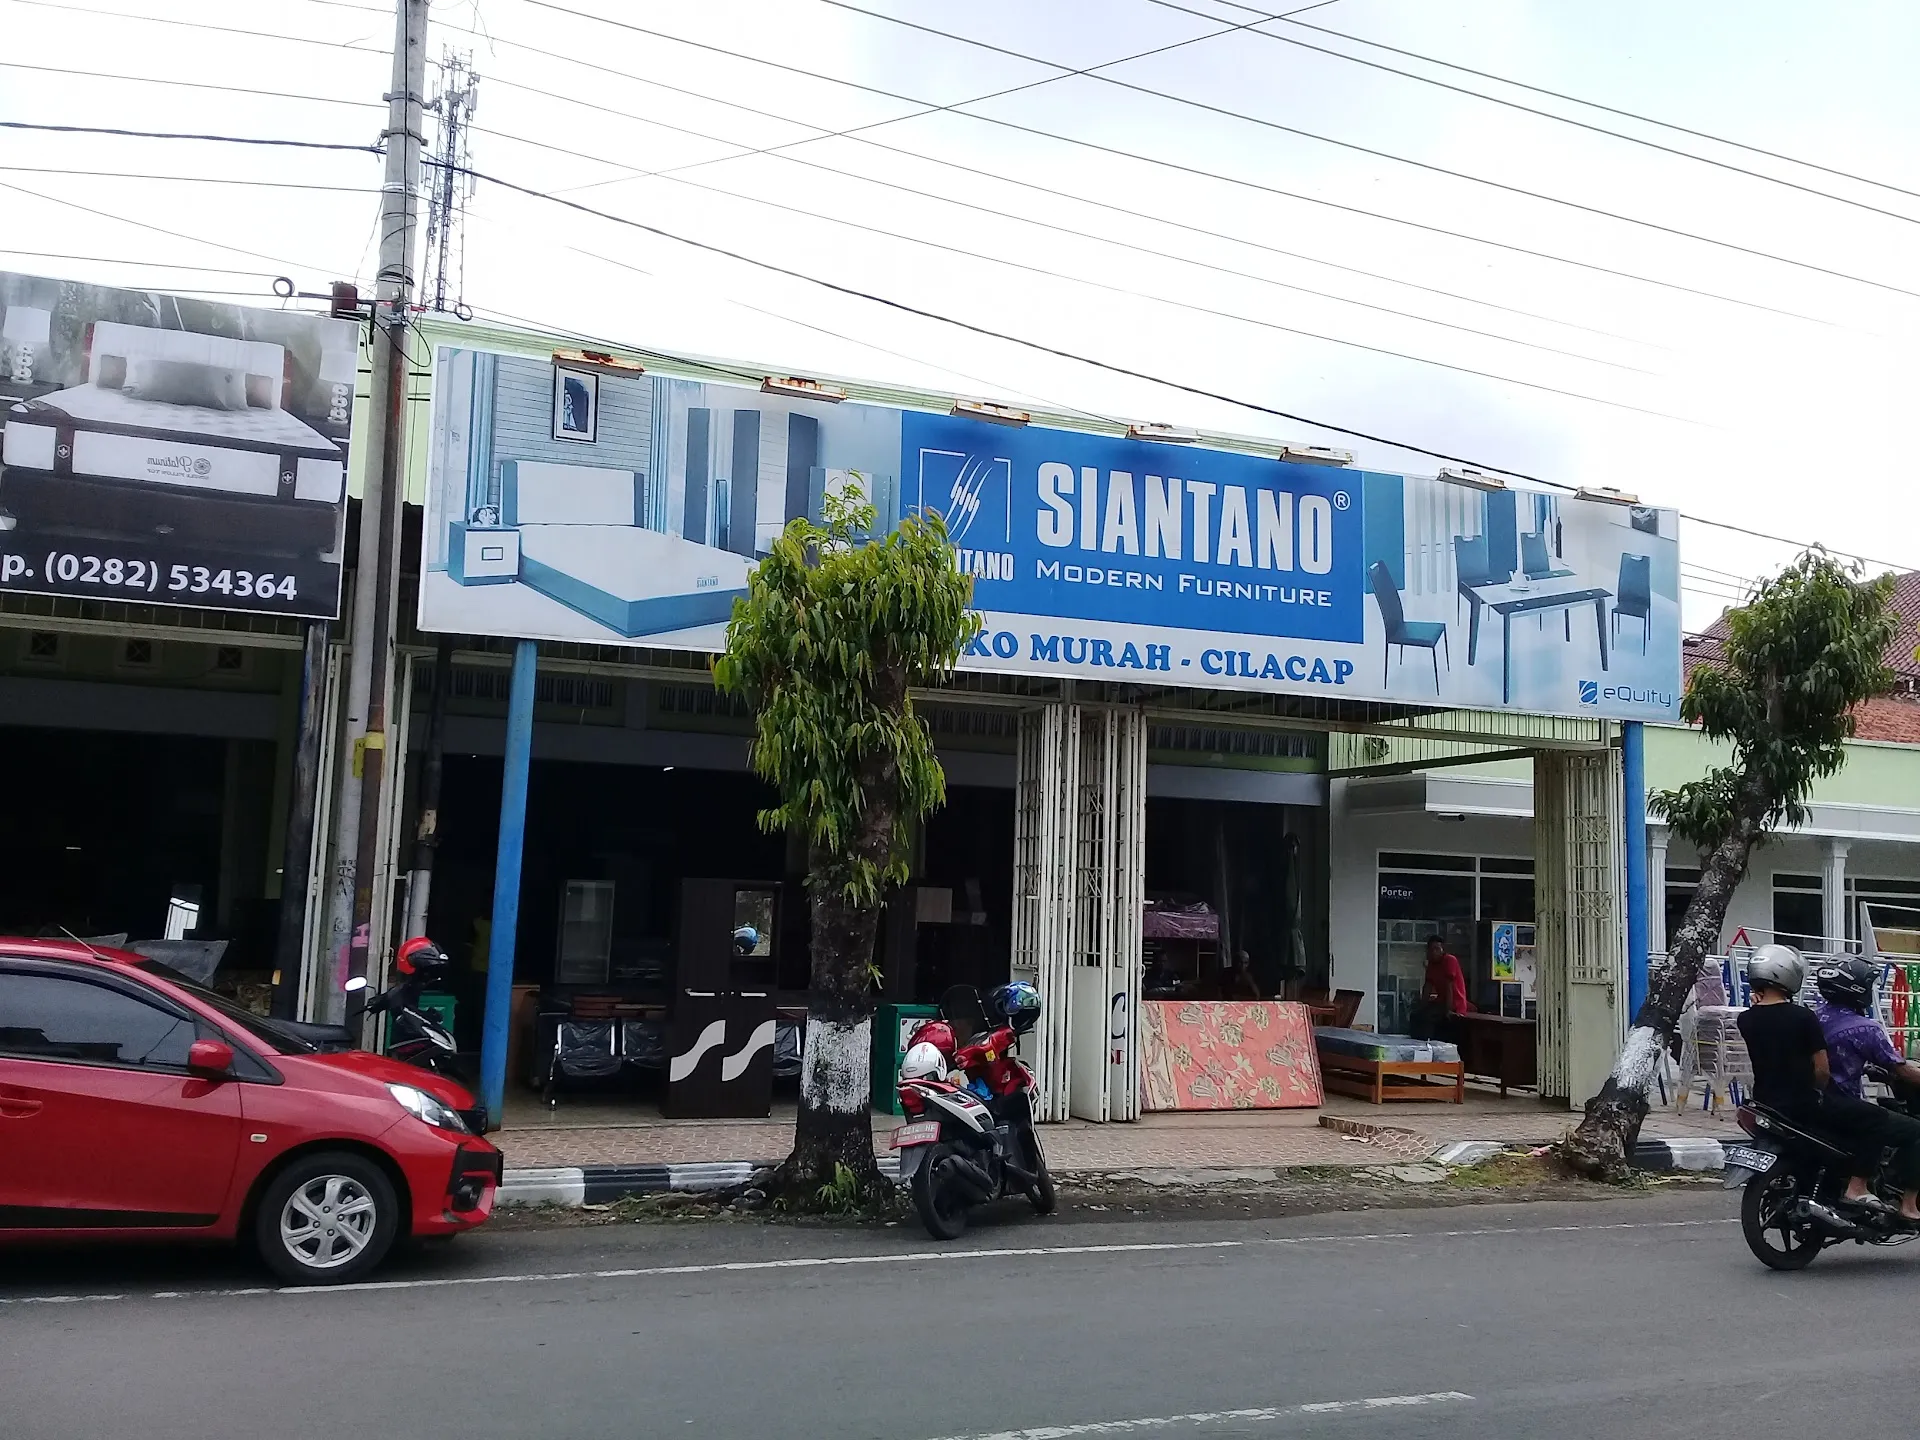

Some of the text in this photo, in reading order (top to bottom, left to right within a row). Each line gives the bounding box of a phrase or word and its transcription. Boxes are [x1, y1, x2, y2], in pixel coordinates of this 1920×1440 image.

[0, 551, 298, 601] p. (0282) 534364
[962, 629, 1019, 659] KO
[1030, 633, 1171, 672] MURAH
[1200, 648, 1354, 685] CILACAP
[1603, 686, 1671, 708] eQuity
[1381, 885, 1413, 897] Porter
